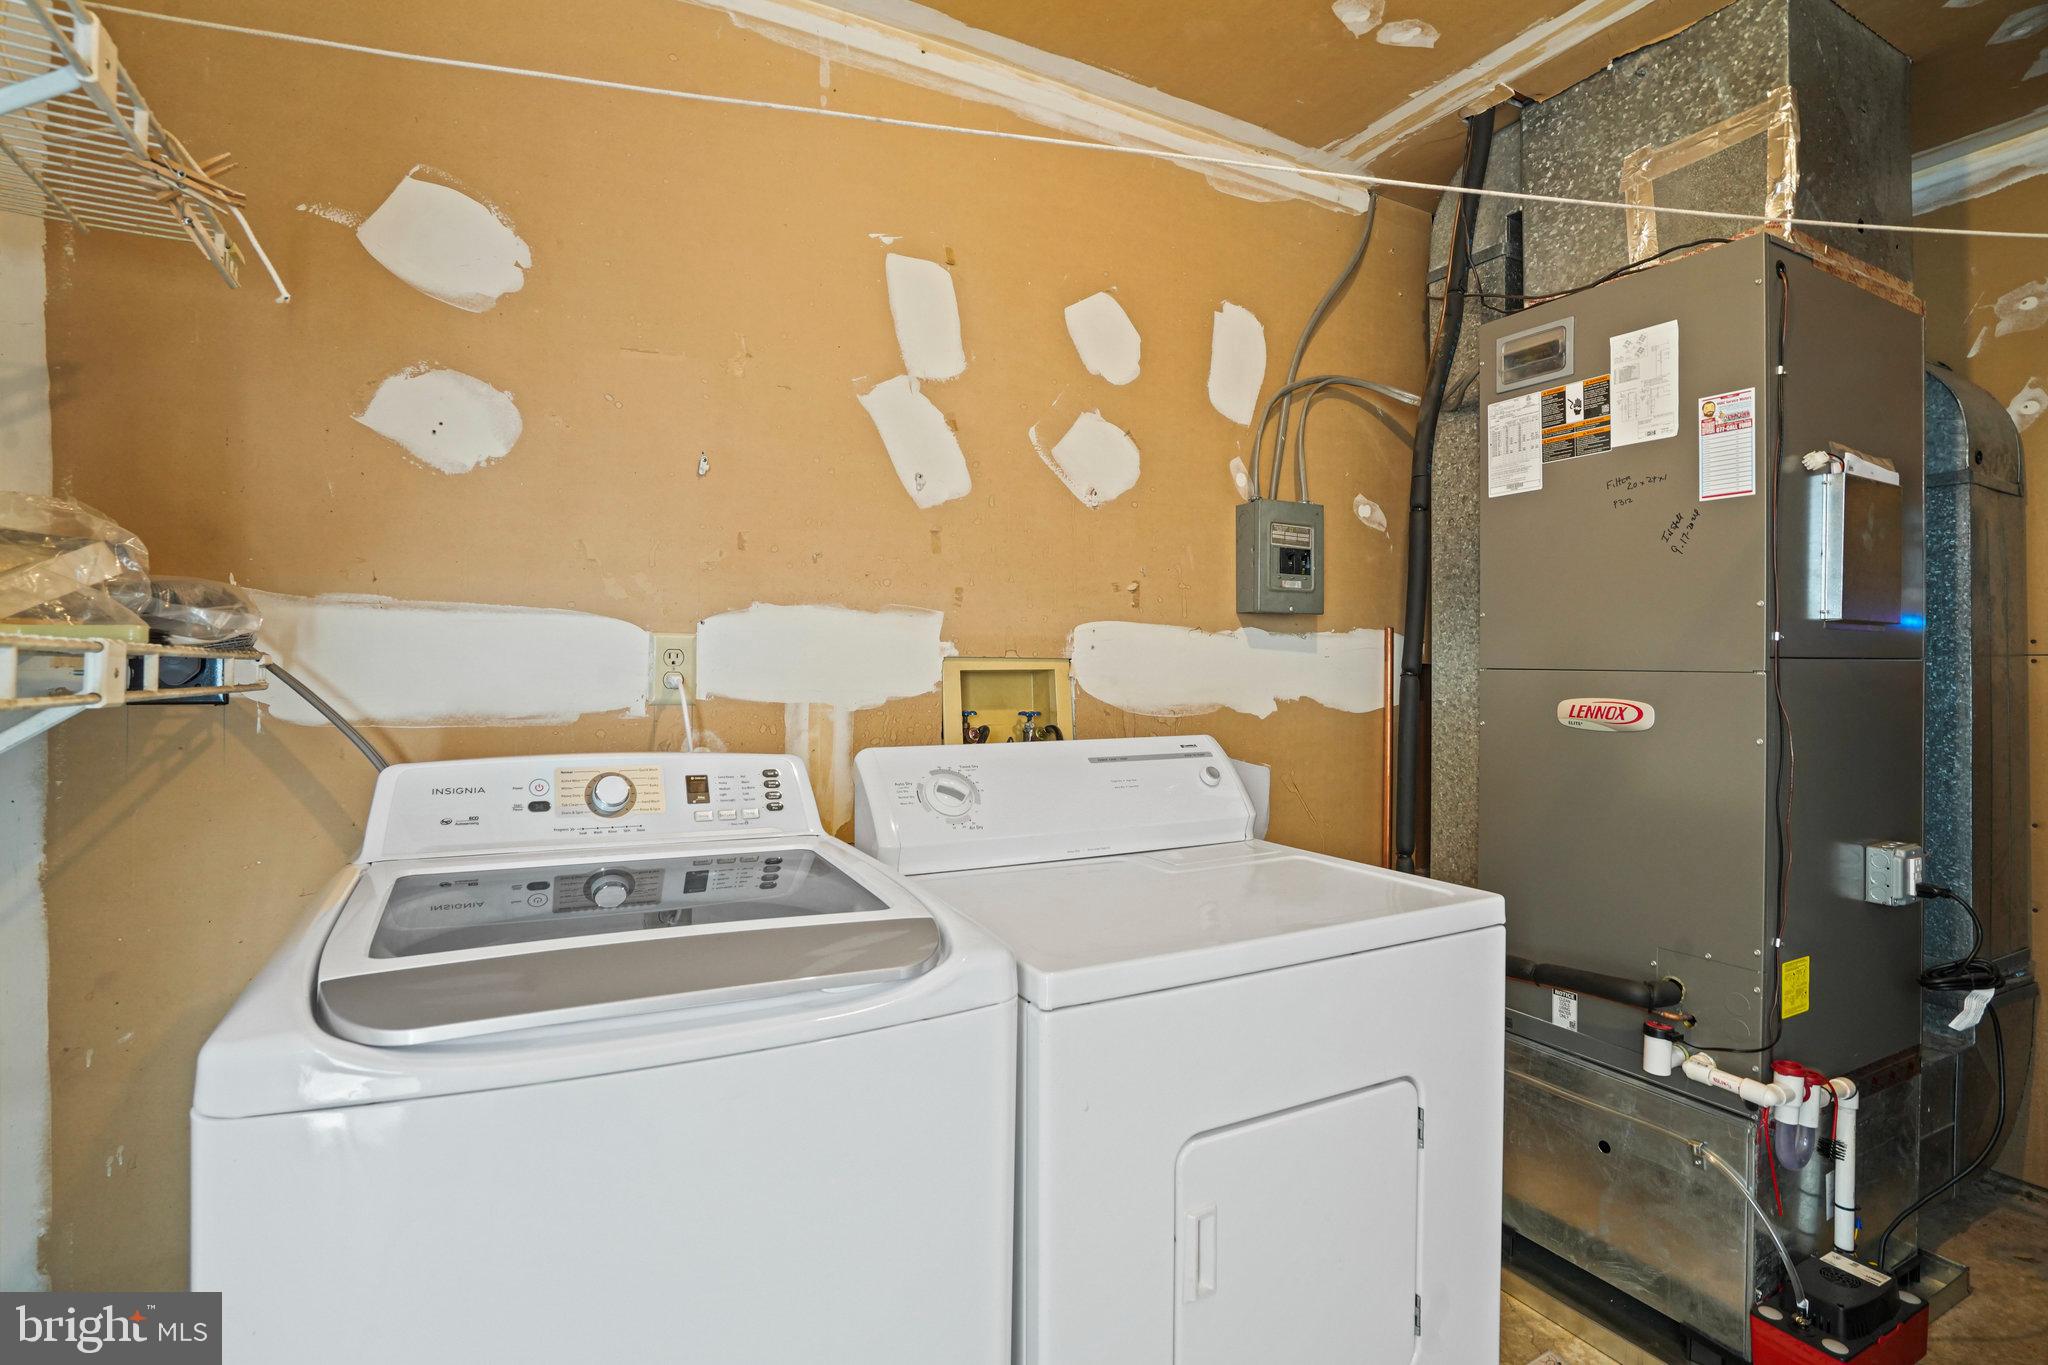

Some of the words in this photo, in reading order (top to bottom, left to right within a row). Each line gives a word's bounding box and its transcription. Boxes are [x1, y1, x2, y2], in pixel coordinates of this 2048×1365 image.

[1627, 482, 1638, 490] 20
[1568, 704, 1628, 720] LENNOX
[432, 787, 486, 795] INSIGNIA
[1555, 989, 1575, 1000] NOTICE
